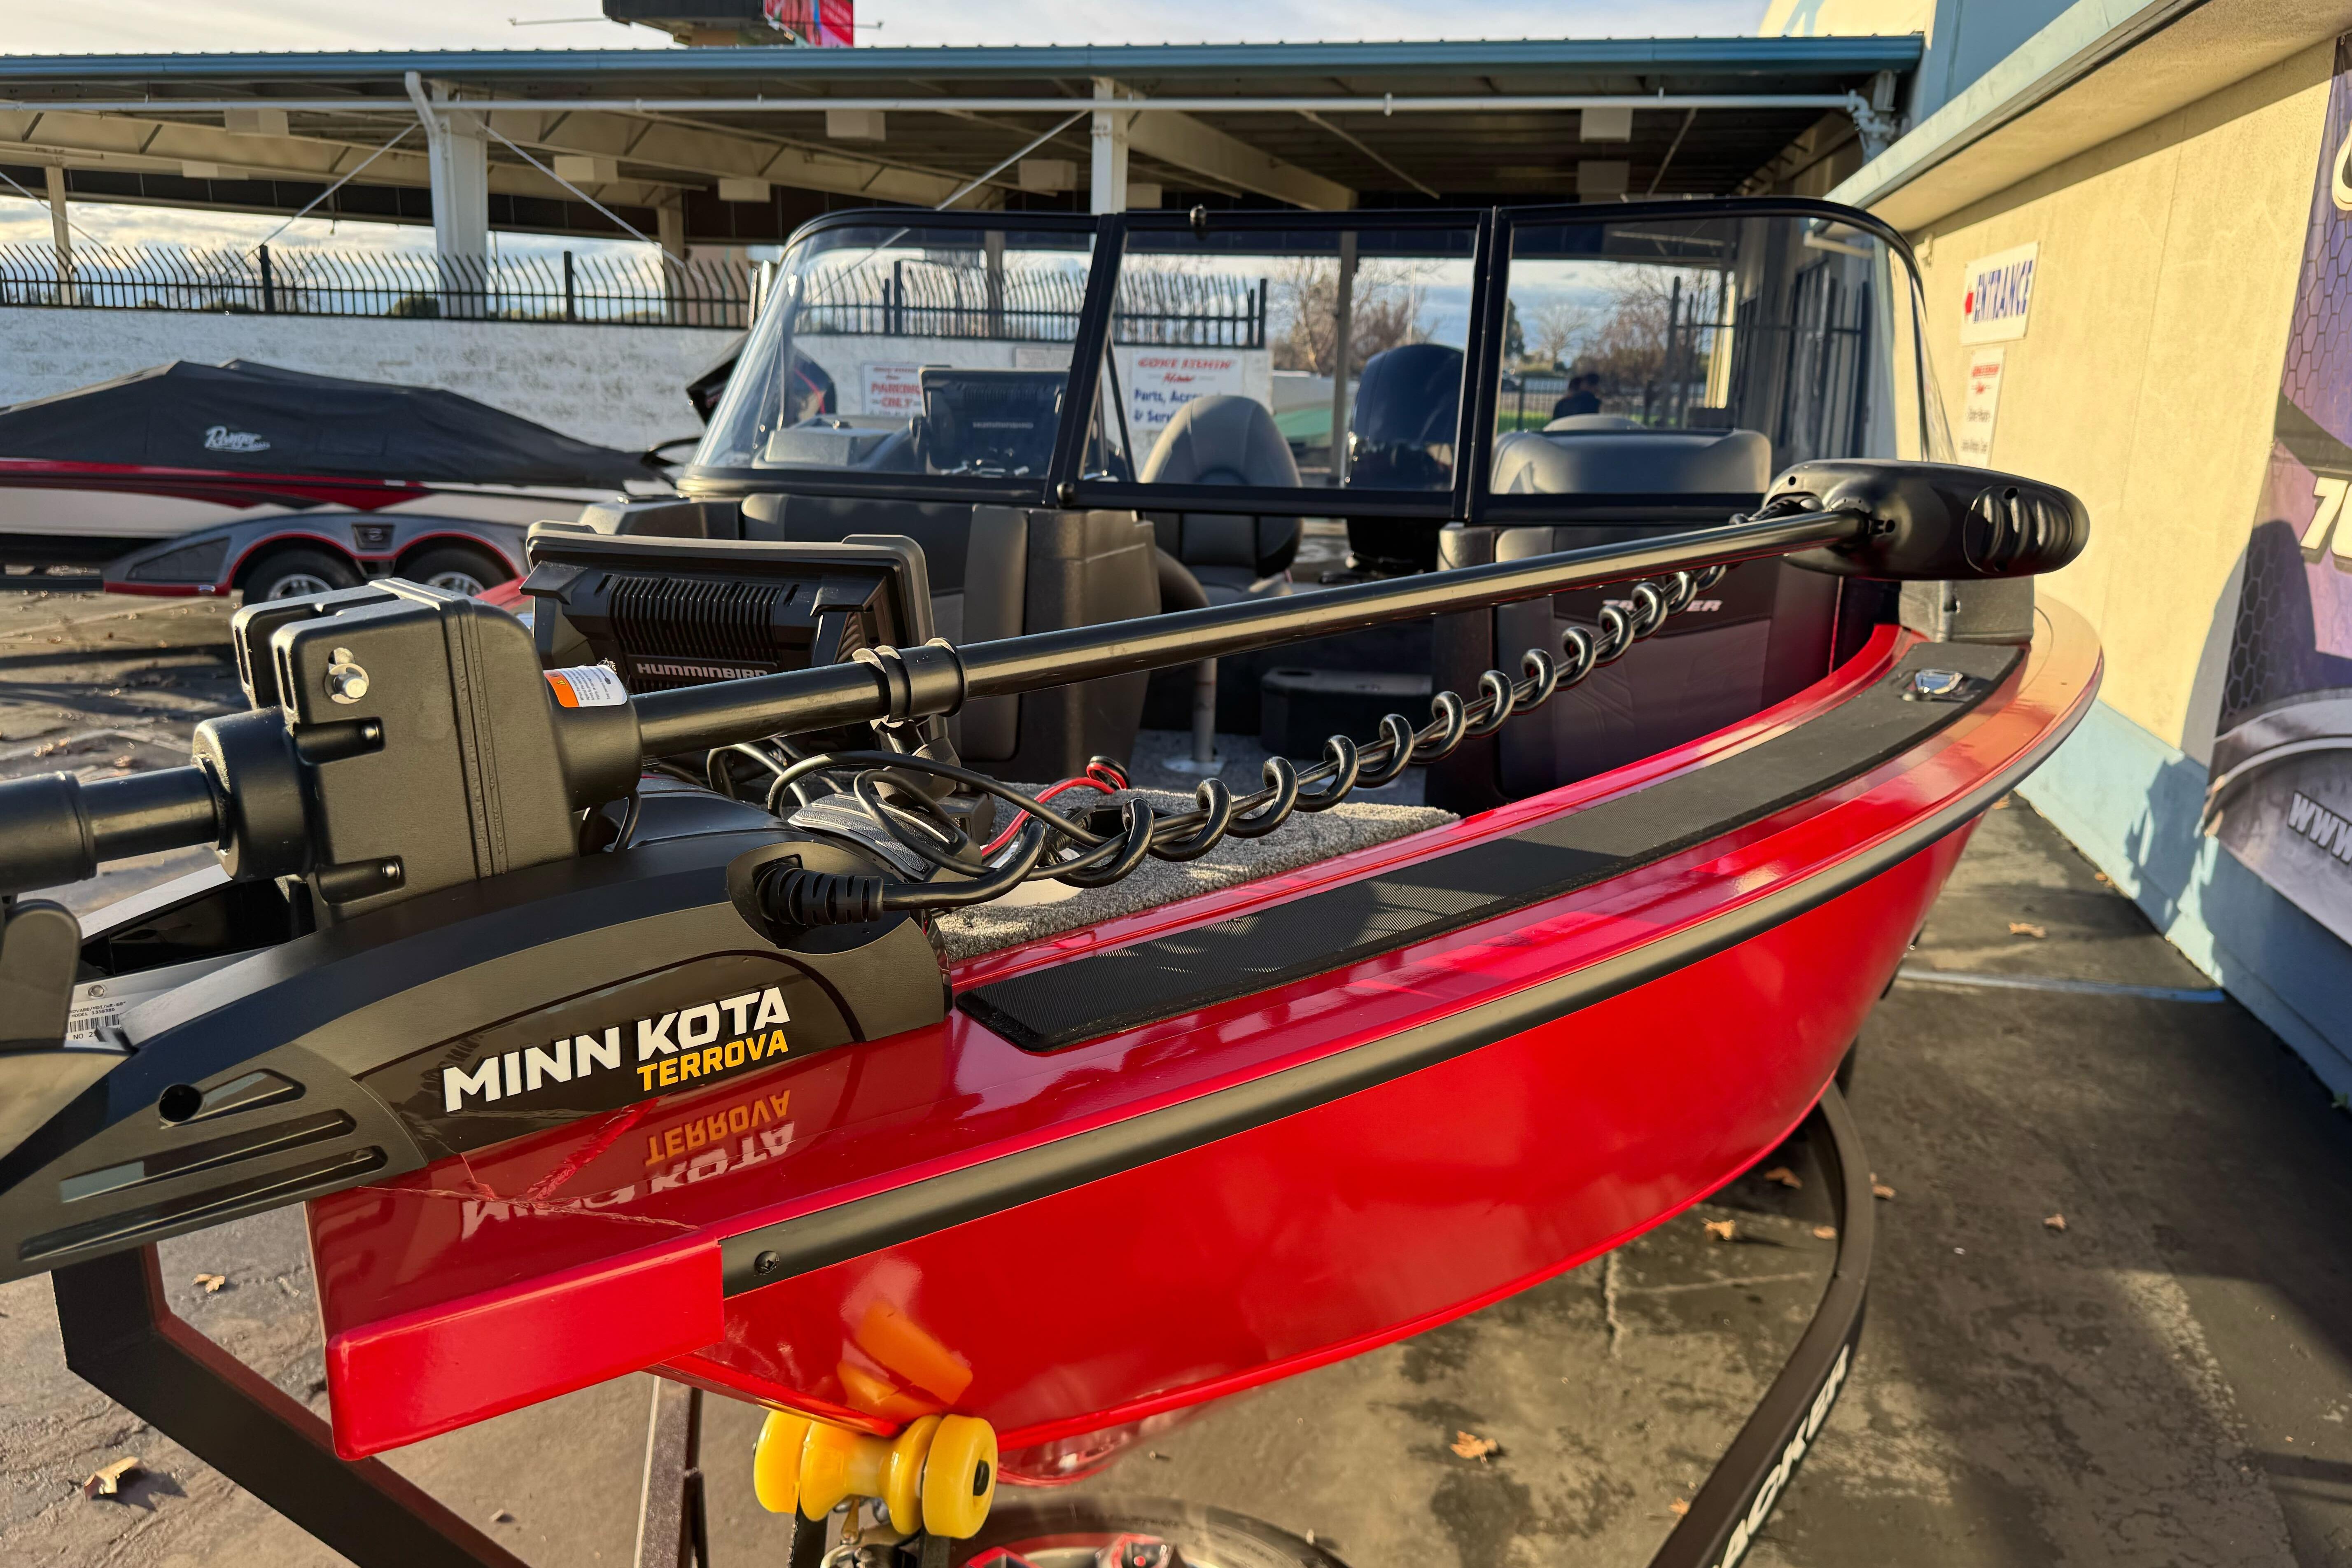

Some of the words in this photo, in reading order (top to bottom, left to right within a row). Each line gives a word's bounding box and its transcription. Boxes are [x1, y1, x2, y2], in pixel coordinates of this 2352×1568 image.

[637, 663, 768, 679] HUMMINBIRD
[443, 1026, 621, 1113] MINN
[637, 987, 791, 1061] KOTA
[637, 1029, 789, 1092] TERROVA
